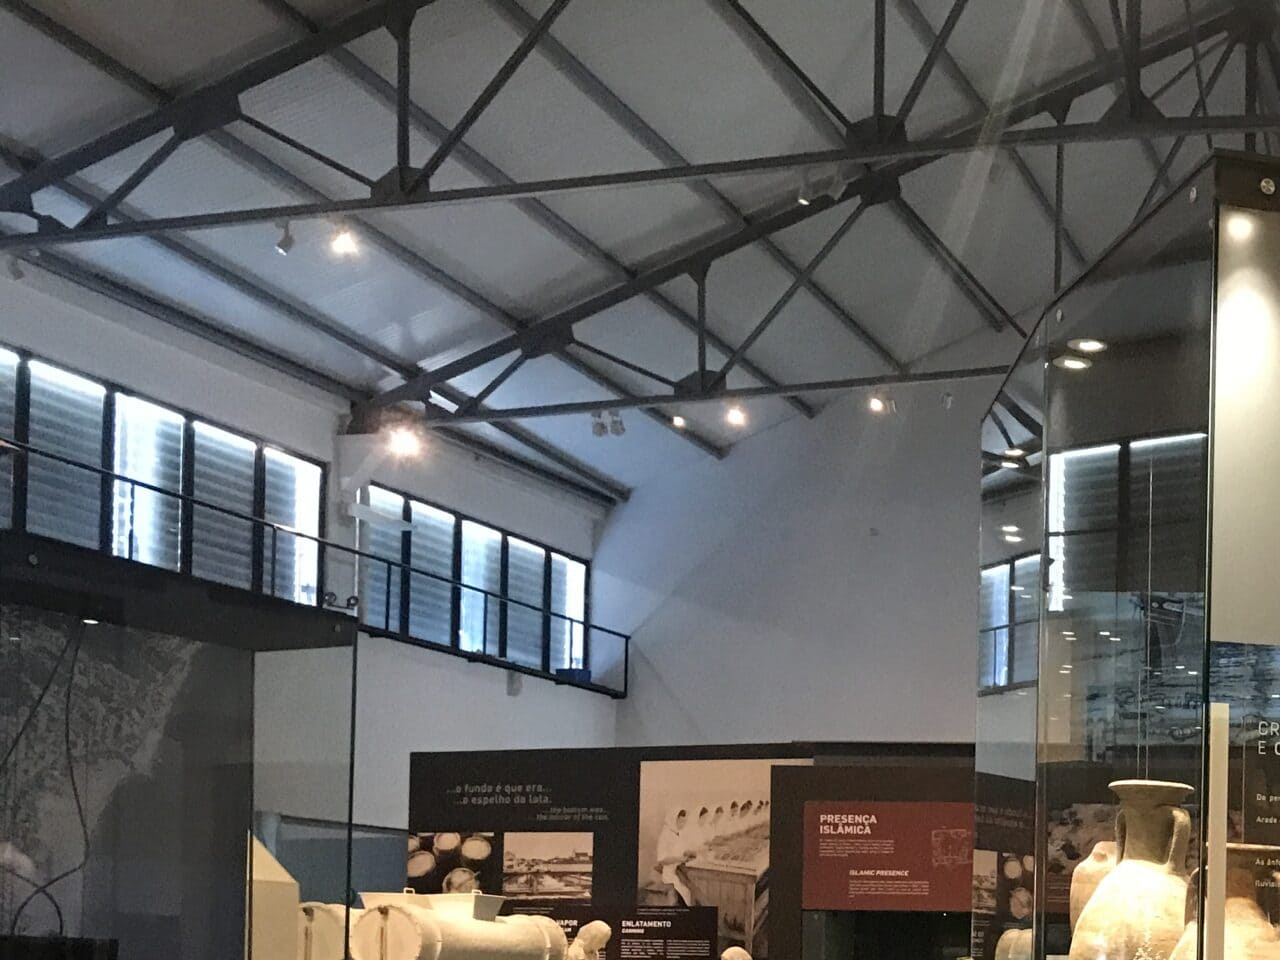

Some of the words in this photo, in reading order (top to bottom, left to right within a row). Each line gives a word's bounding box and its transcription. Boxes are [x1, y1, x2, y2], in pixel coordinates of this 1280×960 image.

[1258, 741, 1267, 755] E
[504, 785, 523, 796] que
[471, 794, 512, 806] espelho
[819, 814, 878, 825] PRESENÇA
[1256, 815, 1278, 824] Arade
[819, 823, 872, 835] ISLÂMICA
[621, 920, 672, 928] ENLATAMENTO
